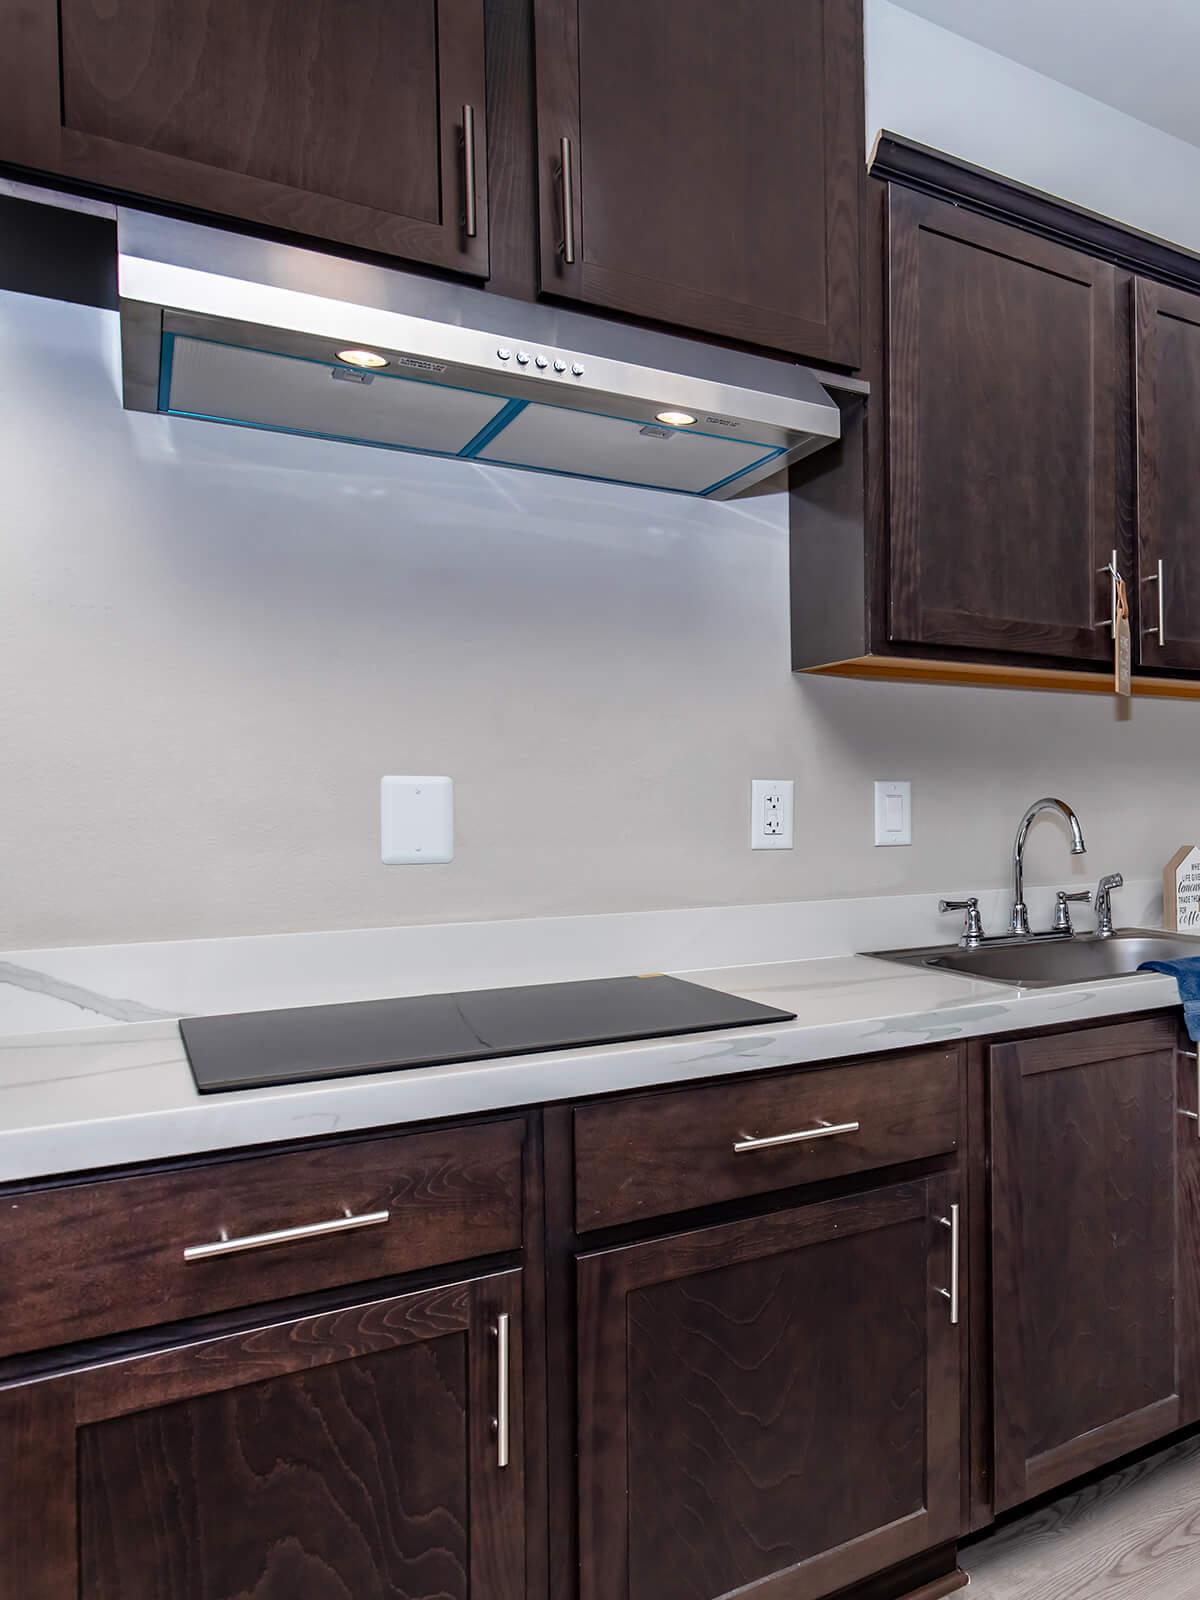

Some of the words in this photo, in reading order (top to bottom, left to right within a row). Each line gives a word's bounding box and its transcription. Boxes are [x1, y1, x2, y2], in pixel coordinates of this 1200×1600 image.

[1182, 873, 1191, 882] LIFE
[1178, 881, 1200, 893] lemons
[1178, 896, 1191, 904] TRADE
[1179, 906, 1187, 914] FOR
